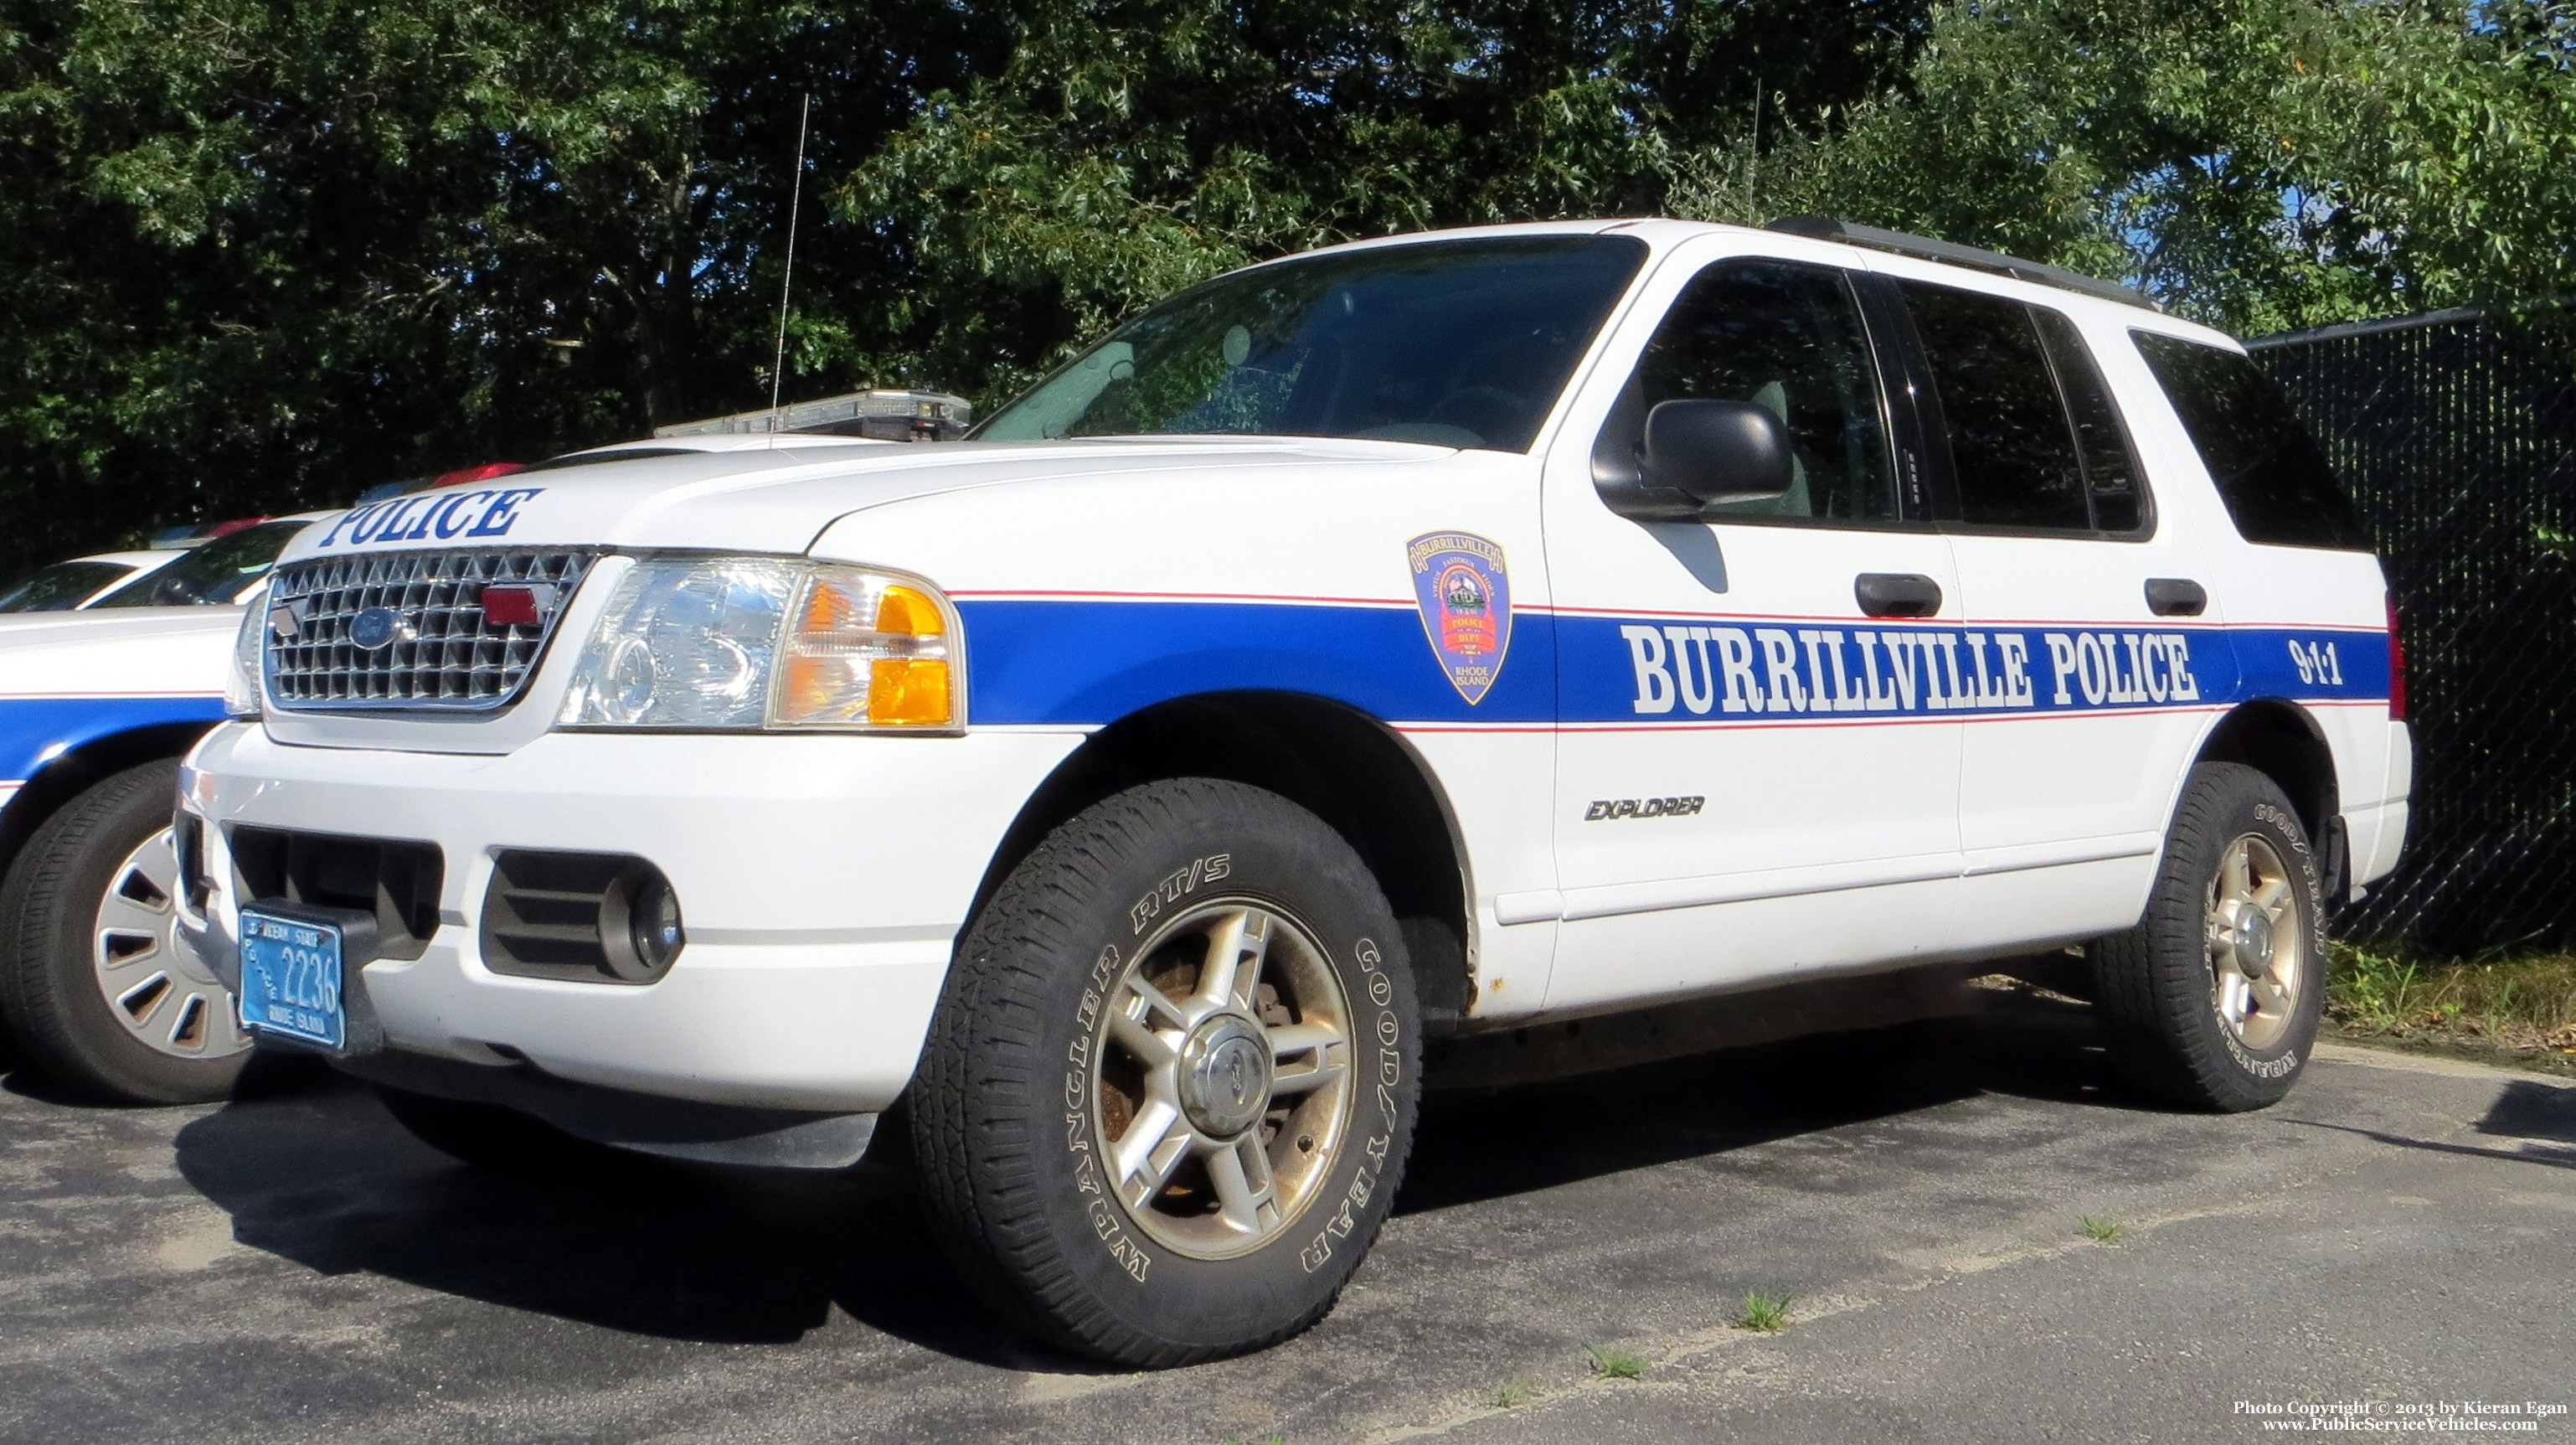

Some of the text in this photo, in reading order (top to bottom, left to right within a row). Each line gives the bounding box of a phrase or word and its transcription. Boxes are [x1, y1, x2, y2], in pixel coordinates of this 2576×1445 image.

[318, 488, 548, 549] POLICE
[1419, 537, 1492, 557] BURRILLVILLE
[1451, 618, 1484, 628] POLICE
[1455, 666, 1489, 676] RHODE
[1456, 676, 1489, 686] ISLAND
[1620, 625, 2200, 715] BURRILLVILLE POLICE
[1584, 796, 1705, 821] EXPLORER
[281, 947, 336, 1014] 2236
[1065, 943, 1152, 1283] WRANGLER
